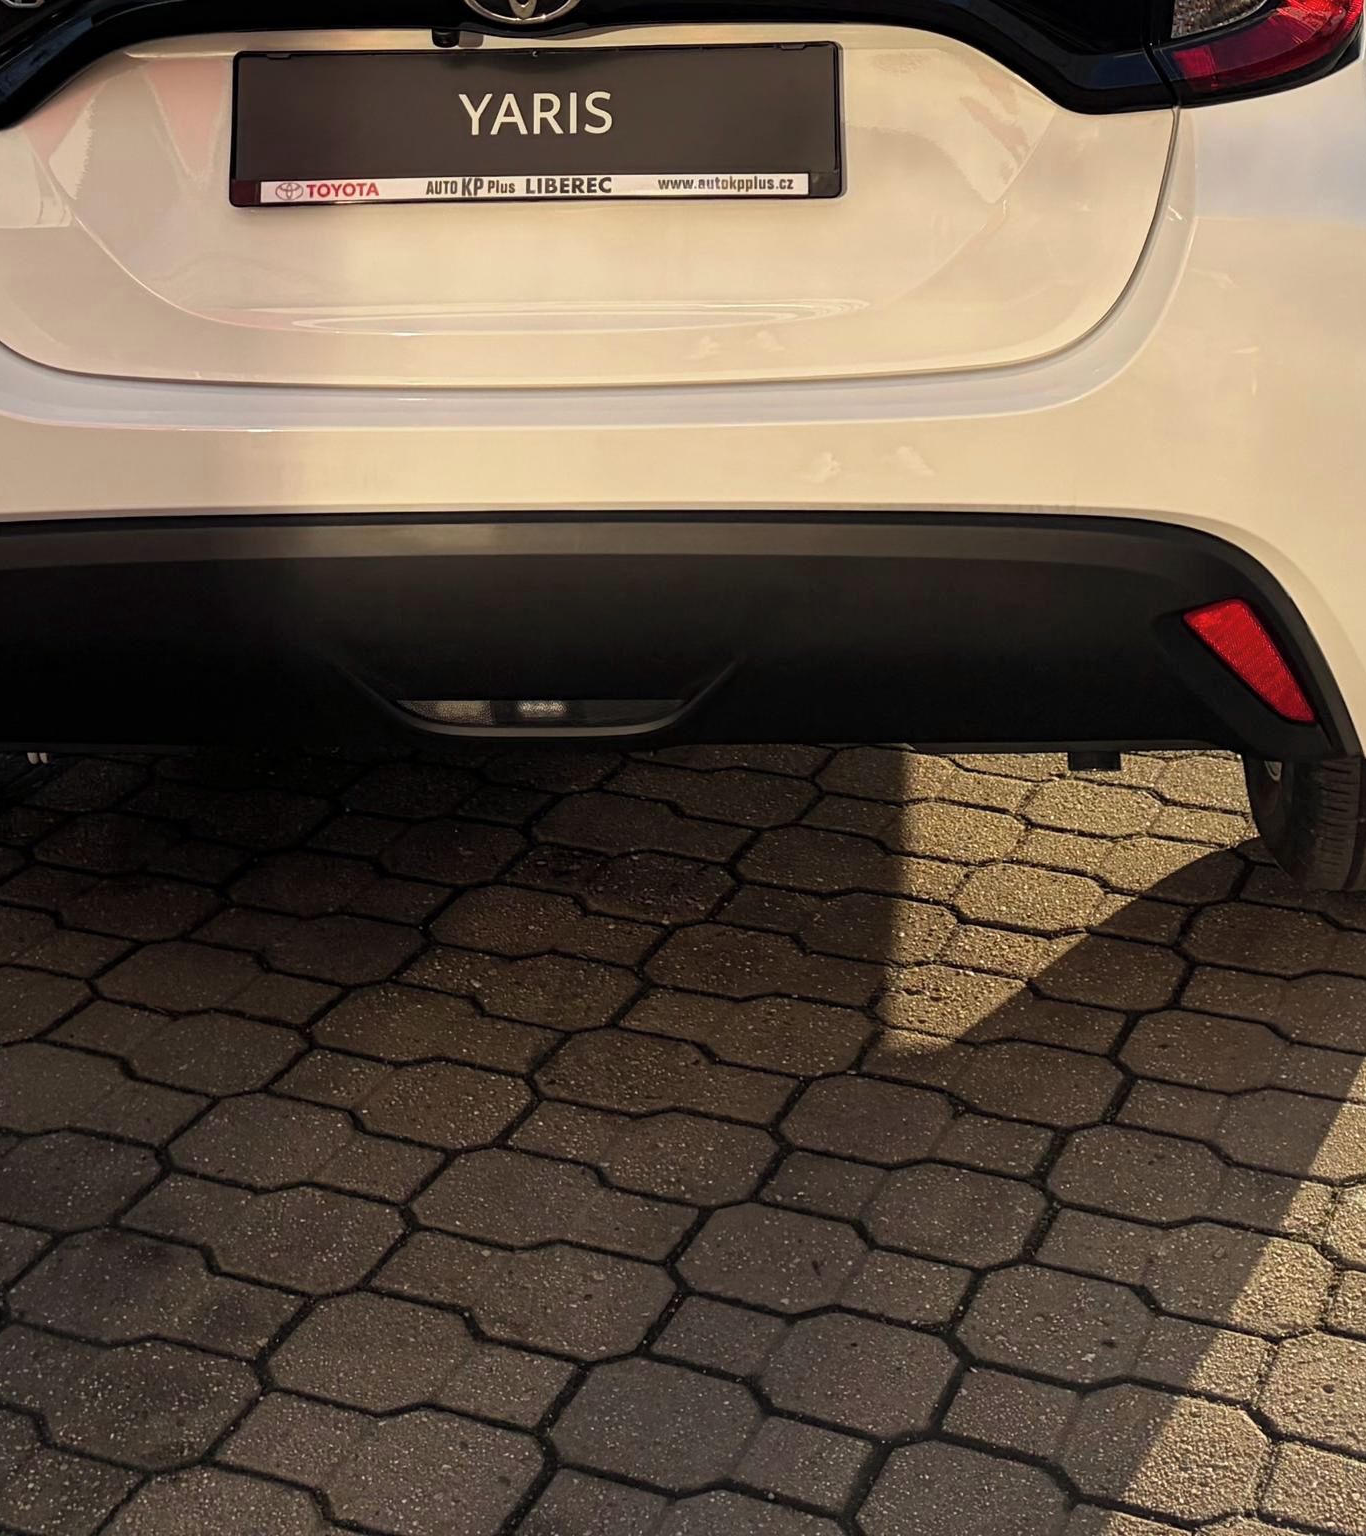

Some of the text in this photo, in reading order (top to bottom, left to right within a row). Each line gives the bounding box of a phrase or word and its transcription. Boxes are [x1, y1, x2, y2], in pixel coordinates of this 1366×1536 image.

[458, 90, 614, 136] YARIS
[306, 181, 380, 199] TOYOTA
[426, 176, 613, 197] AUTO KP Plus LIBEREC
[657, 176, 795, 194] www.autokpplus.cz
